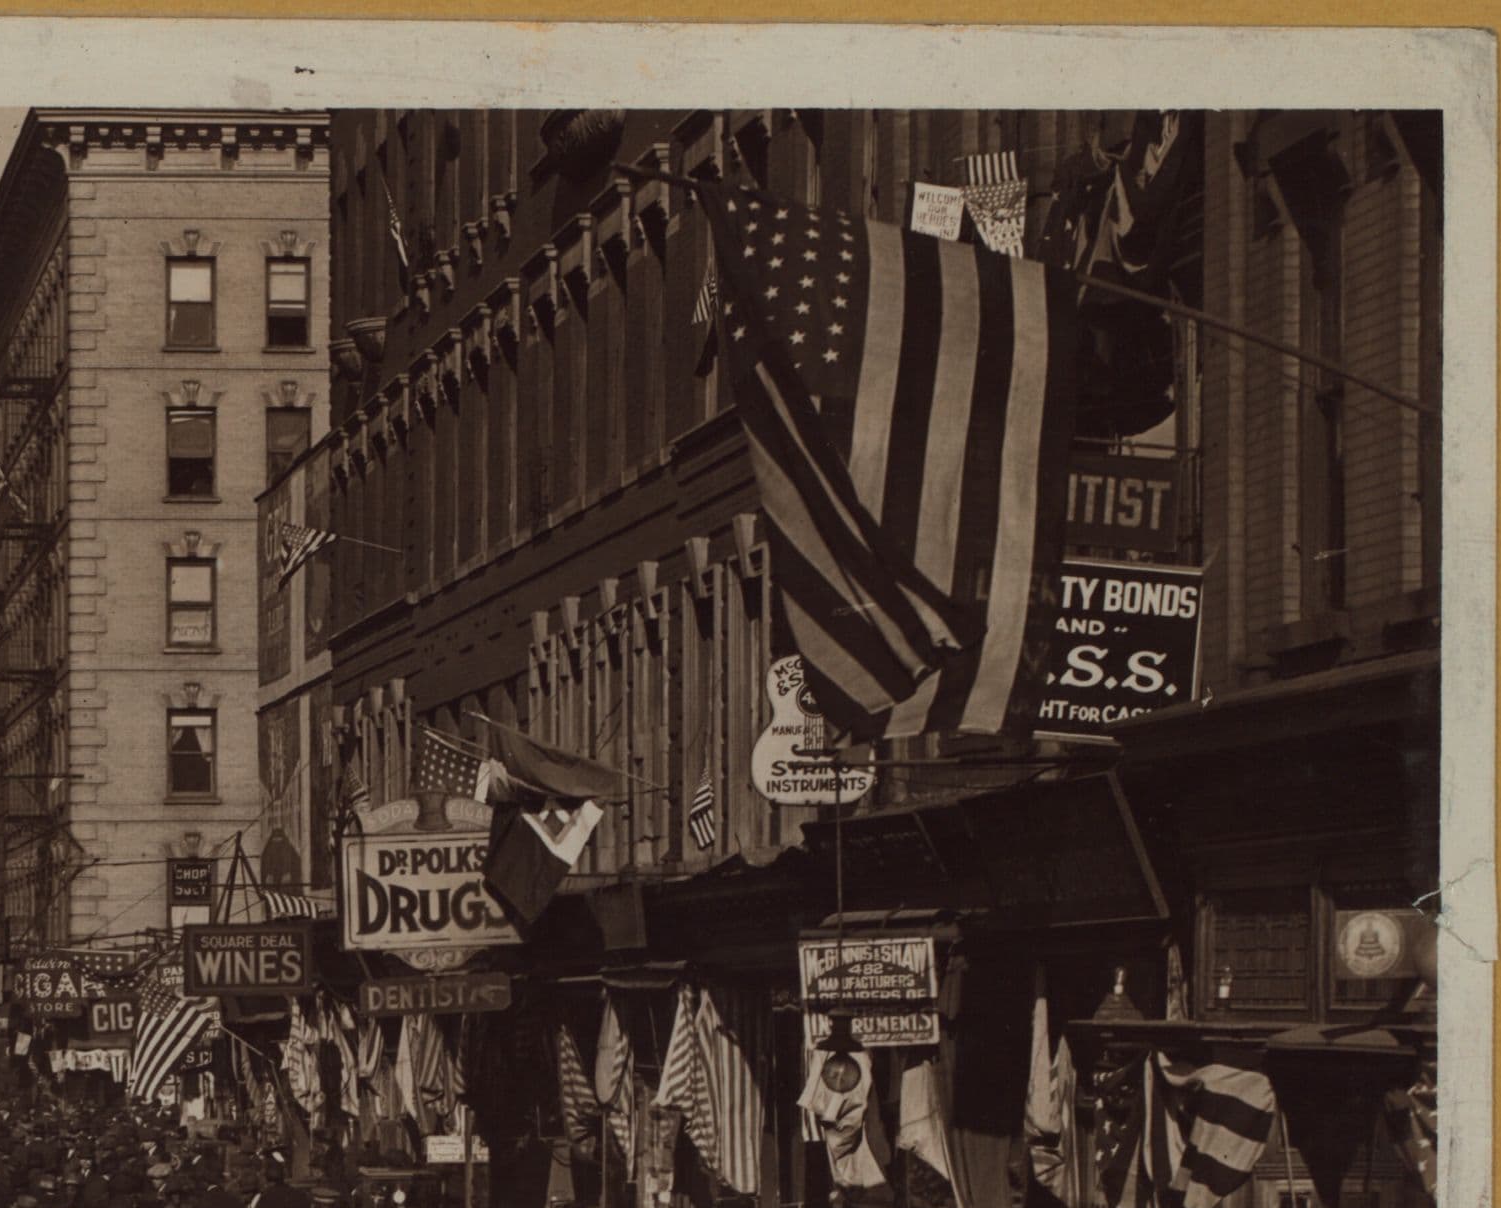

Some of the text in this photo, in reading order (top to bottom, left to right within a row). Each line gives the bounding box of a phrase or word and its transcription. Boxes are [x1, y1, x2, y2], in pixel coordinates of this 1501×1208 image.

[1102, 578, 1198, 619] BONDS
[1055, 616, 1106, 636] AND
[1068, 704, 1100, 723] FOR
[766, 777, 867, 792] INSTRUMENTS
[410, 844, 488, 875] POLK'S
[200, 935, 297, 949] SQUARE DEAL
[194, 950, 302, 985] WINES
[846, 962, 884, 975] 482
[881, 943, 927, 978] SHAW
[817, 974, 916, 992] MANUFACTURERS
[367, 979, 467, 1012] DENTIST
